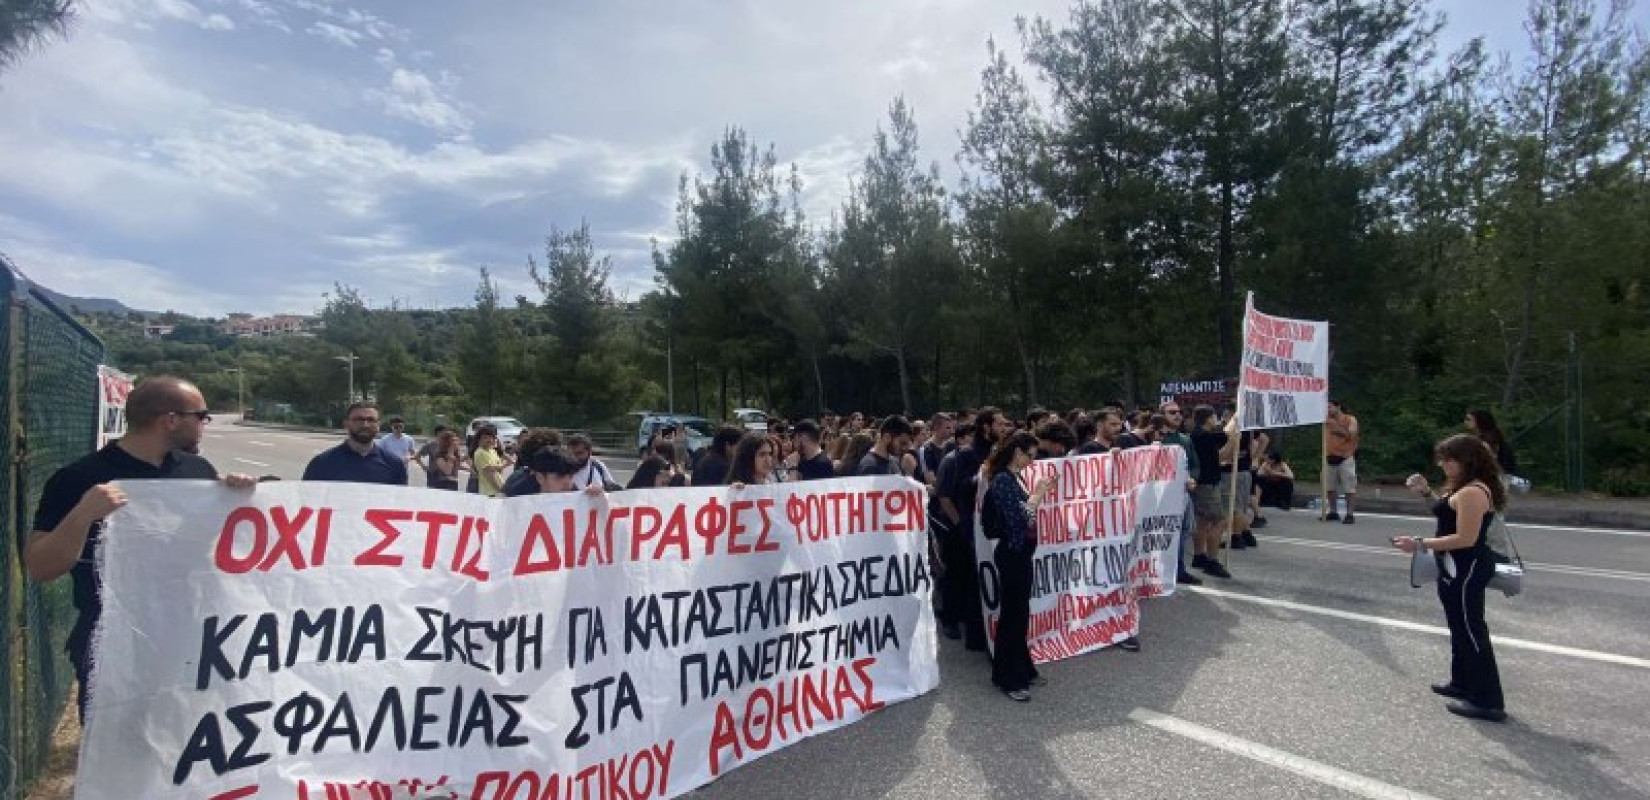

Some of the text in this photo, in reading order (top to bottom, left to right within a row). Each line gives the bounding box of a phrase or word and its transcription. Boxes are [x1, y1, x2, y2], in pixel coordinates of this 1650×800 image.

[214, 490, 925, 582] ΟΧΙ ΣΤΙΣ ΔΙΑΓΡΑΦΕΣ ΦΟΙΤΗΤΩΝ
[196, 603, 387, 690] ΚΑΜΙΑ
[404, 606, 543, 674] ΣΚΕΨΗ
[567, 606, 607, 669] ΓΙΑ
[624, 564, 837, 654] ΚΑΤΑΣΤΑΛΤΙΚΑ
[837, 552, 931, 607] ΣΧΕΔΙΑ
[171, 613, 900, 785] ΑΣΦΑΛΕΙΑΣ ΣΤΑ ΠΑΝΕΠΙΣΤΗΜΙΑ
[708, 658, 886, 777] ΑΘΗΝΑΣ
